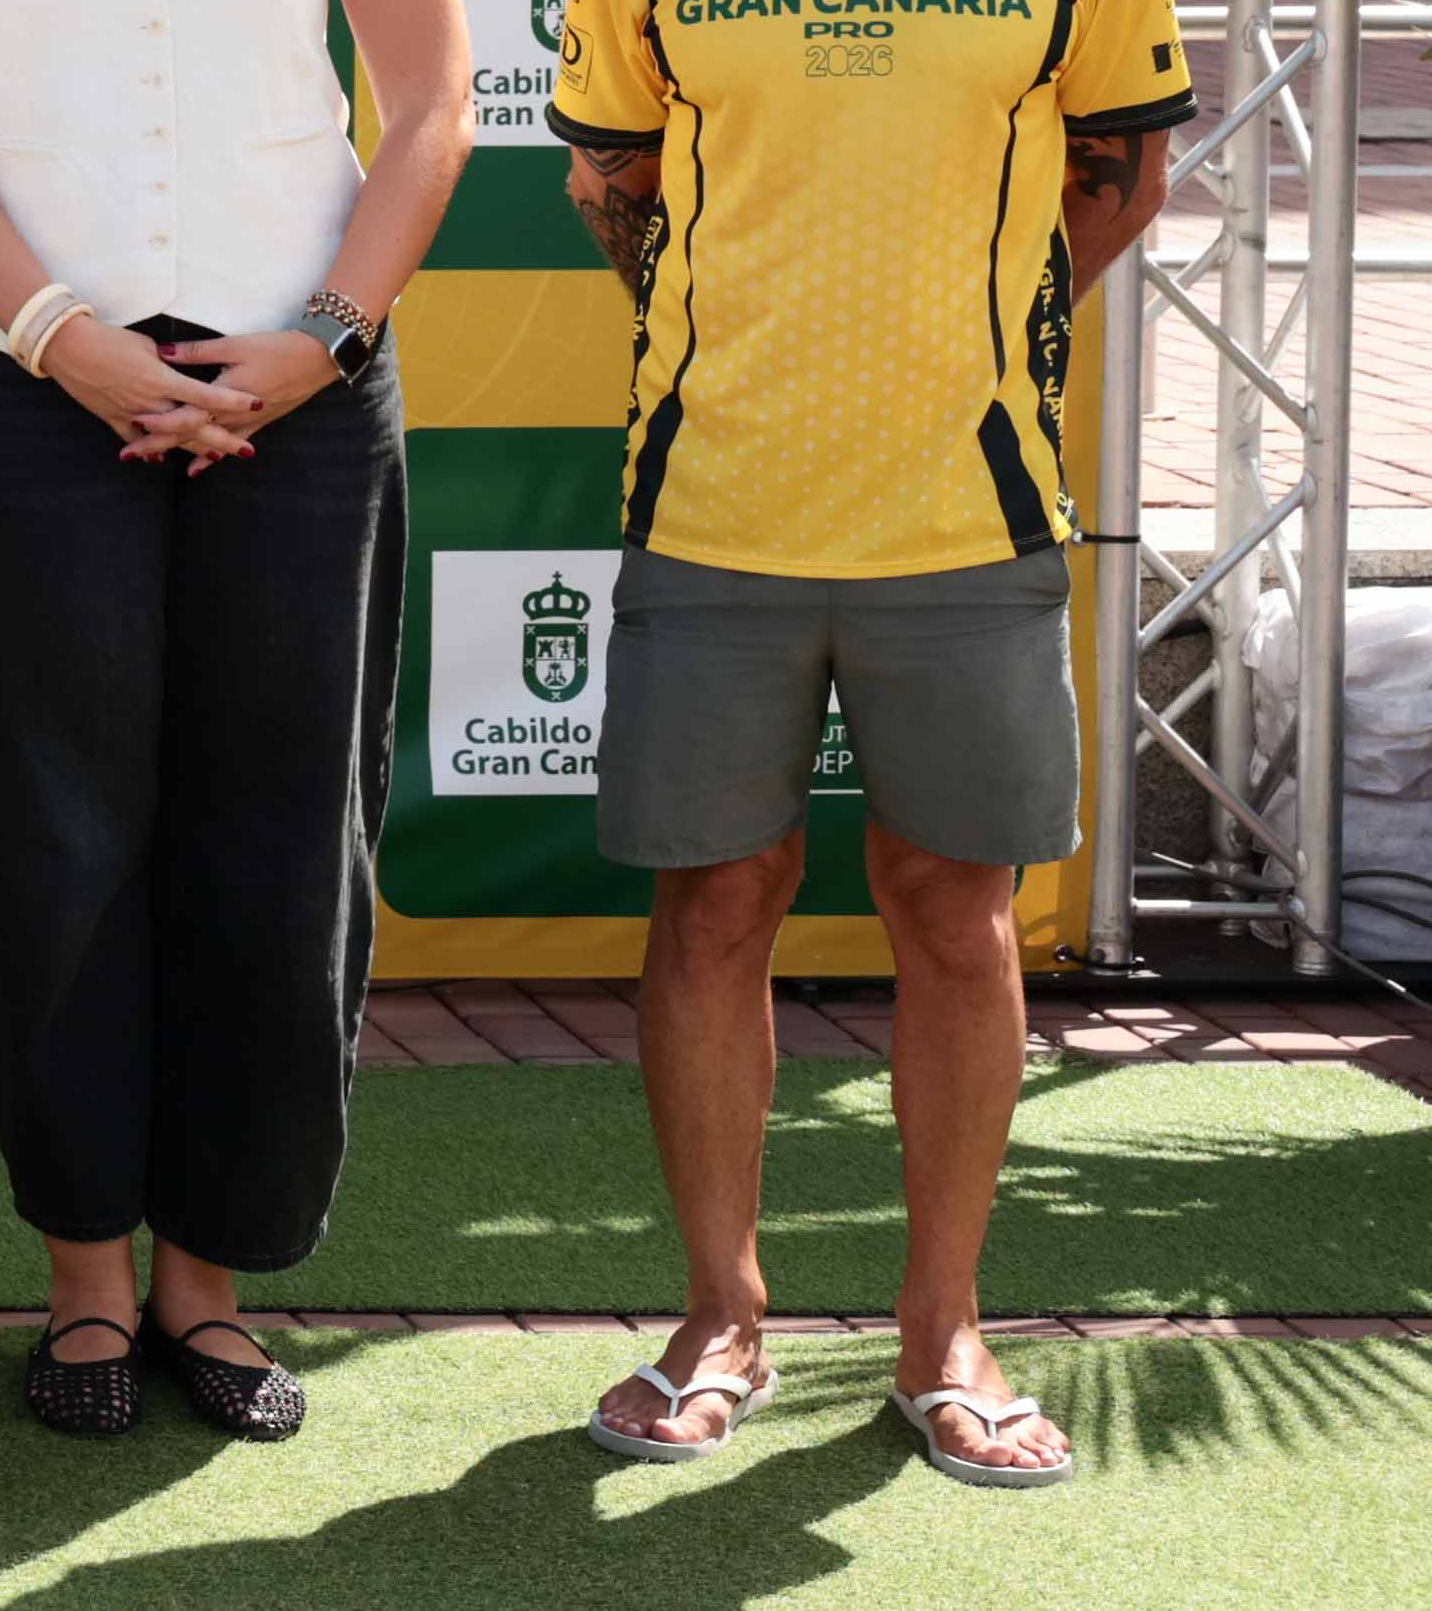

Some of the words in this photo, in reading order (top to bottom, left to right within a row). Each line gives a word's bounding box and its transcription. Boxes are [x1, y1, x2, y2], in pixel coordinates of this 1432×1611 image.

[805, 21, 894, 39] PRO
[805, 45, 894, 78] 2026
[465, 717, 592, 745] Cabildo
[451, 748, 529, 776] Gran
